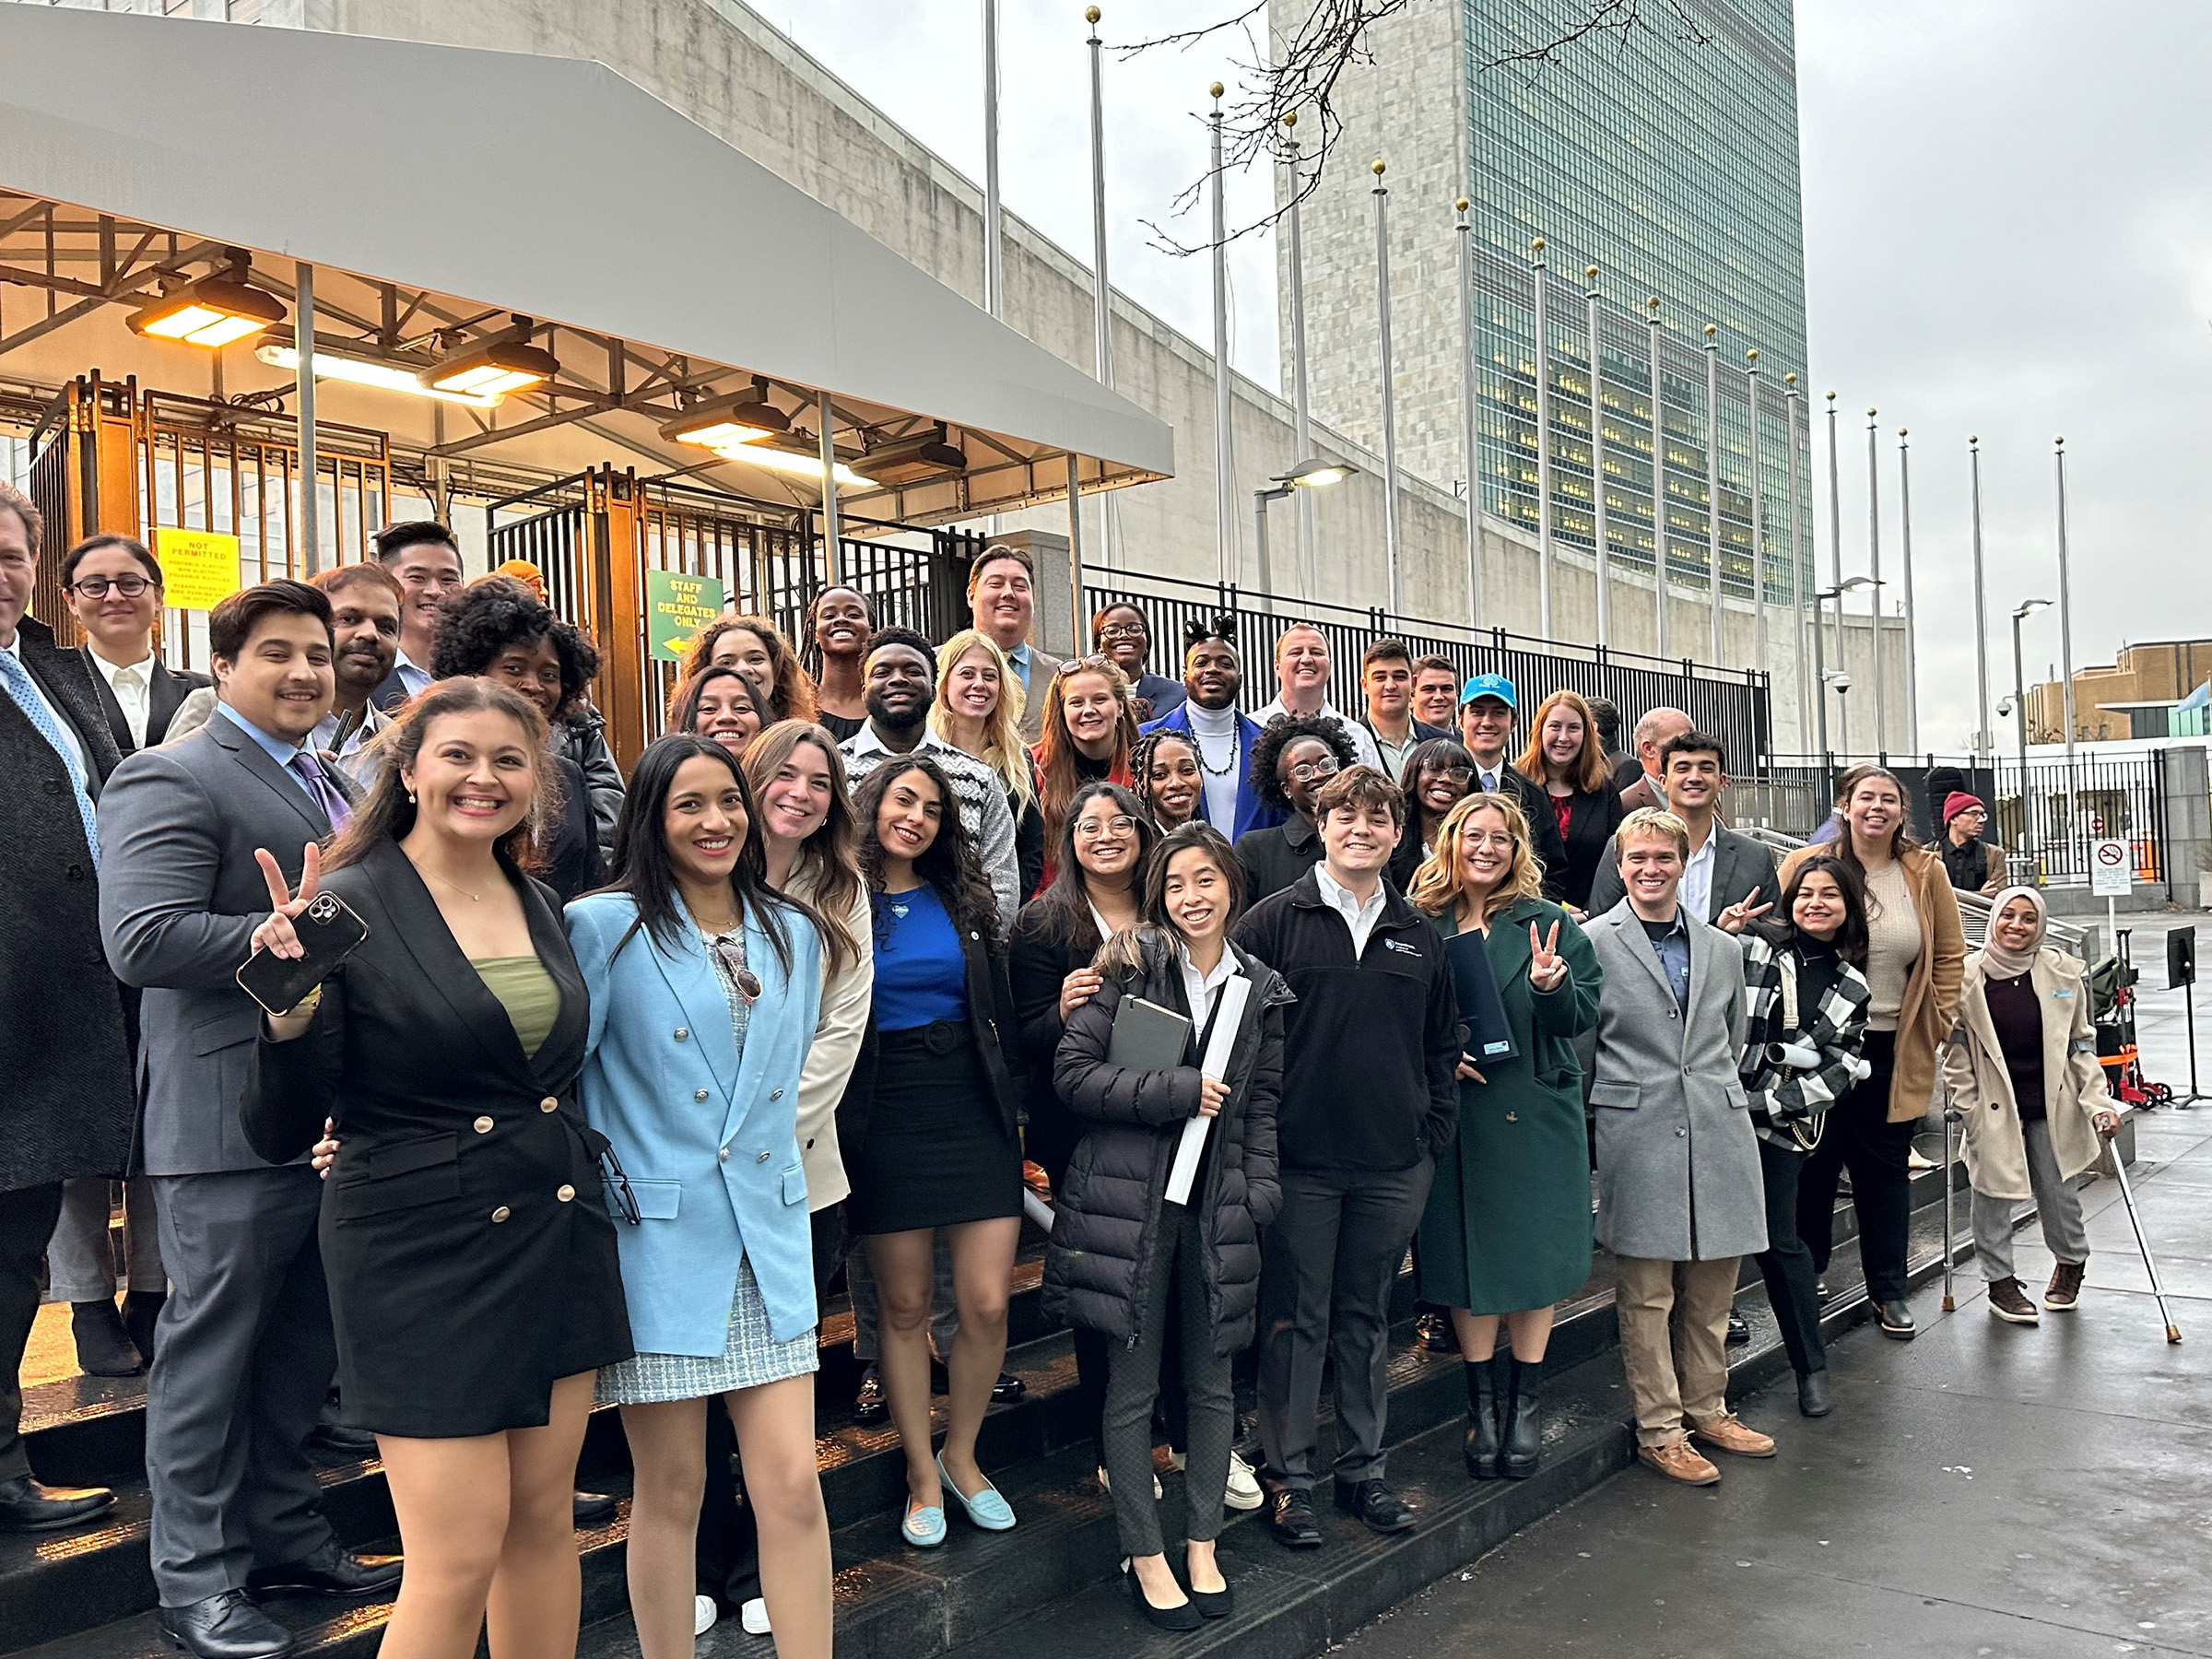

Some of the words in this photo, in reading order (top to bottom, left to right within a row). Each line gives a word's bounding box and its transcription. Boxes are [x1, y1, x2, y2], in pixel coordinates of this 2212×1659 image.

[171, 548, 226, 559] PERMITTED
[670, 580, 702, 594] STAFF
[676, 592, 698, 605] AND
[657, 602, 715, 619] DELEGATES
[674, 615, 701, 629] ONLY
